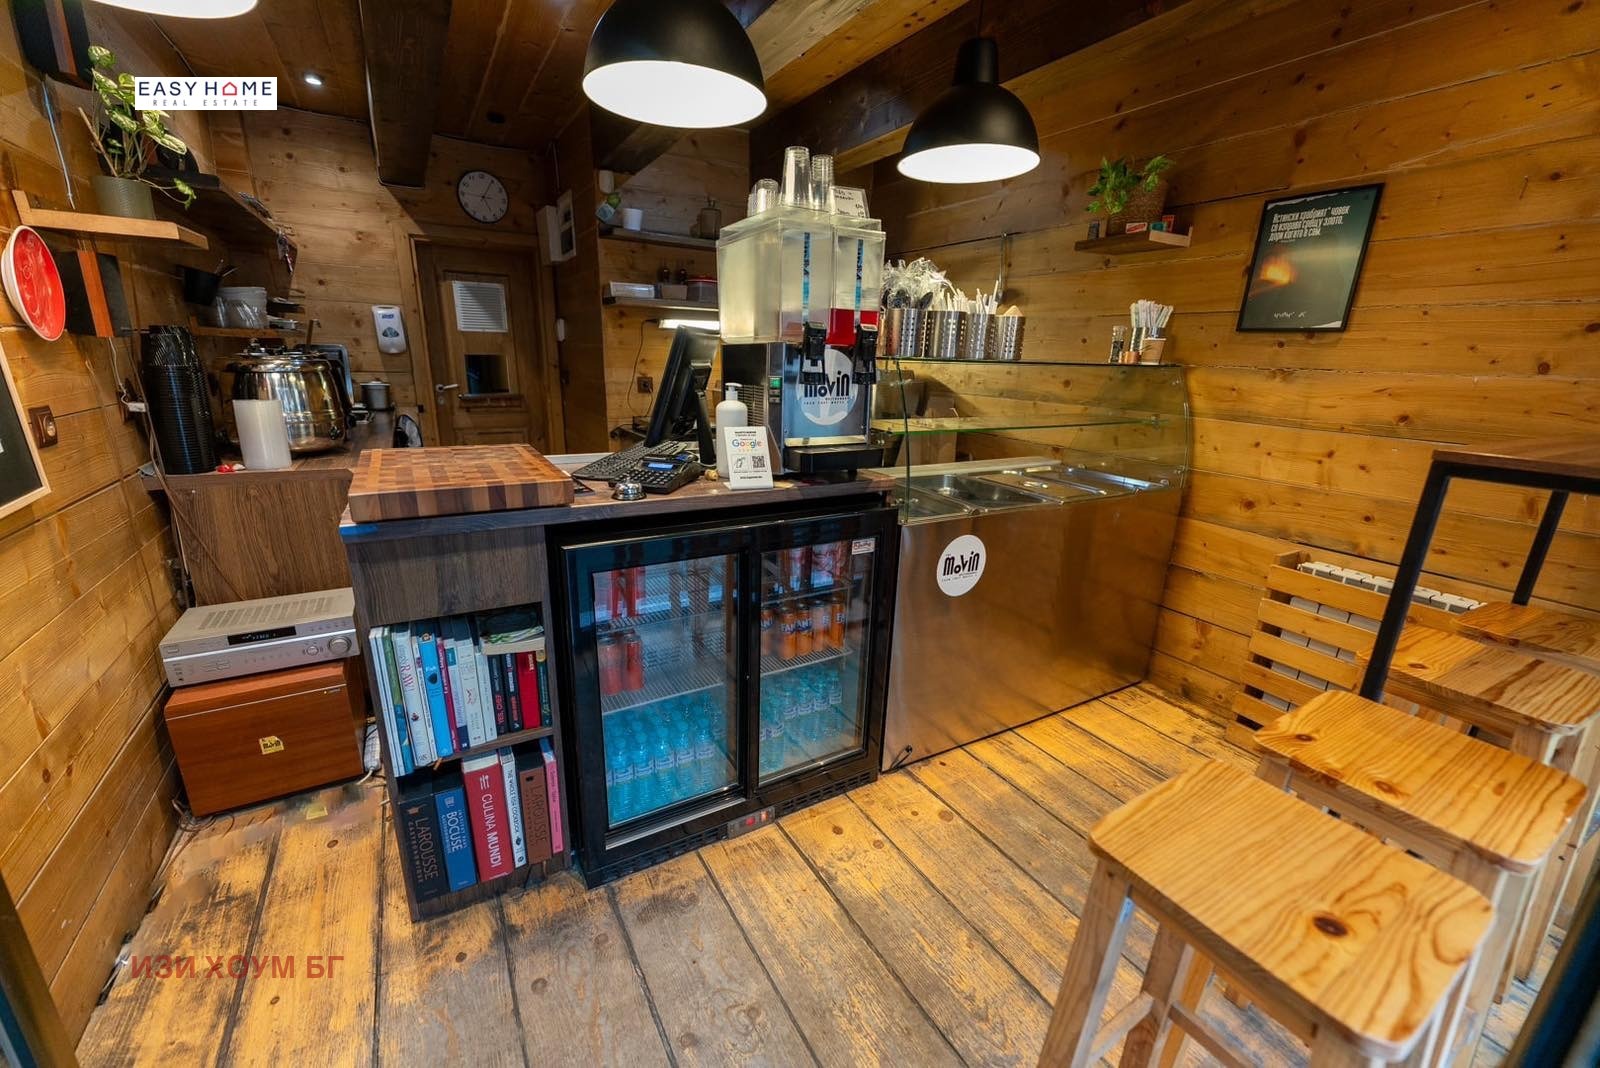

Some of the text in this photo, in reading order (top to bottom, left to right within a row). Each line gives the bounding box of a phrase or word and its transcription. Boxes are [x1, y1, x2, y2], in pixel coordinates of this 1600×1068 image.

[731, 438, 762, 448] Google
[446, 811, 463, 853] BOCUSE
[481, 793, 503, 868] CULINA MUNDI
[533, 785, 548, 844] LAROUSSE
[414, 817, 439, 881] LAROUSSE
